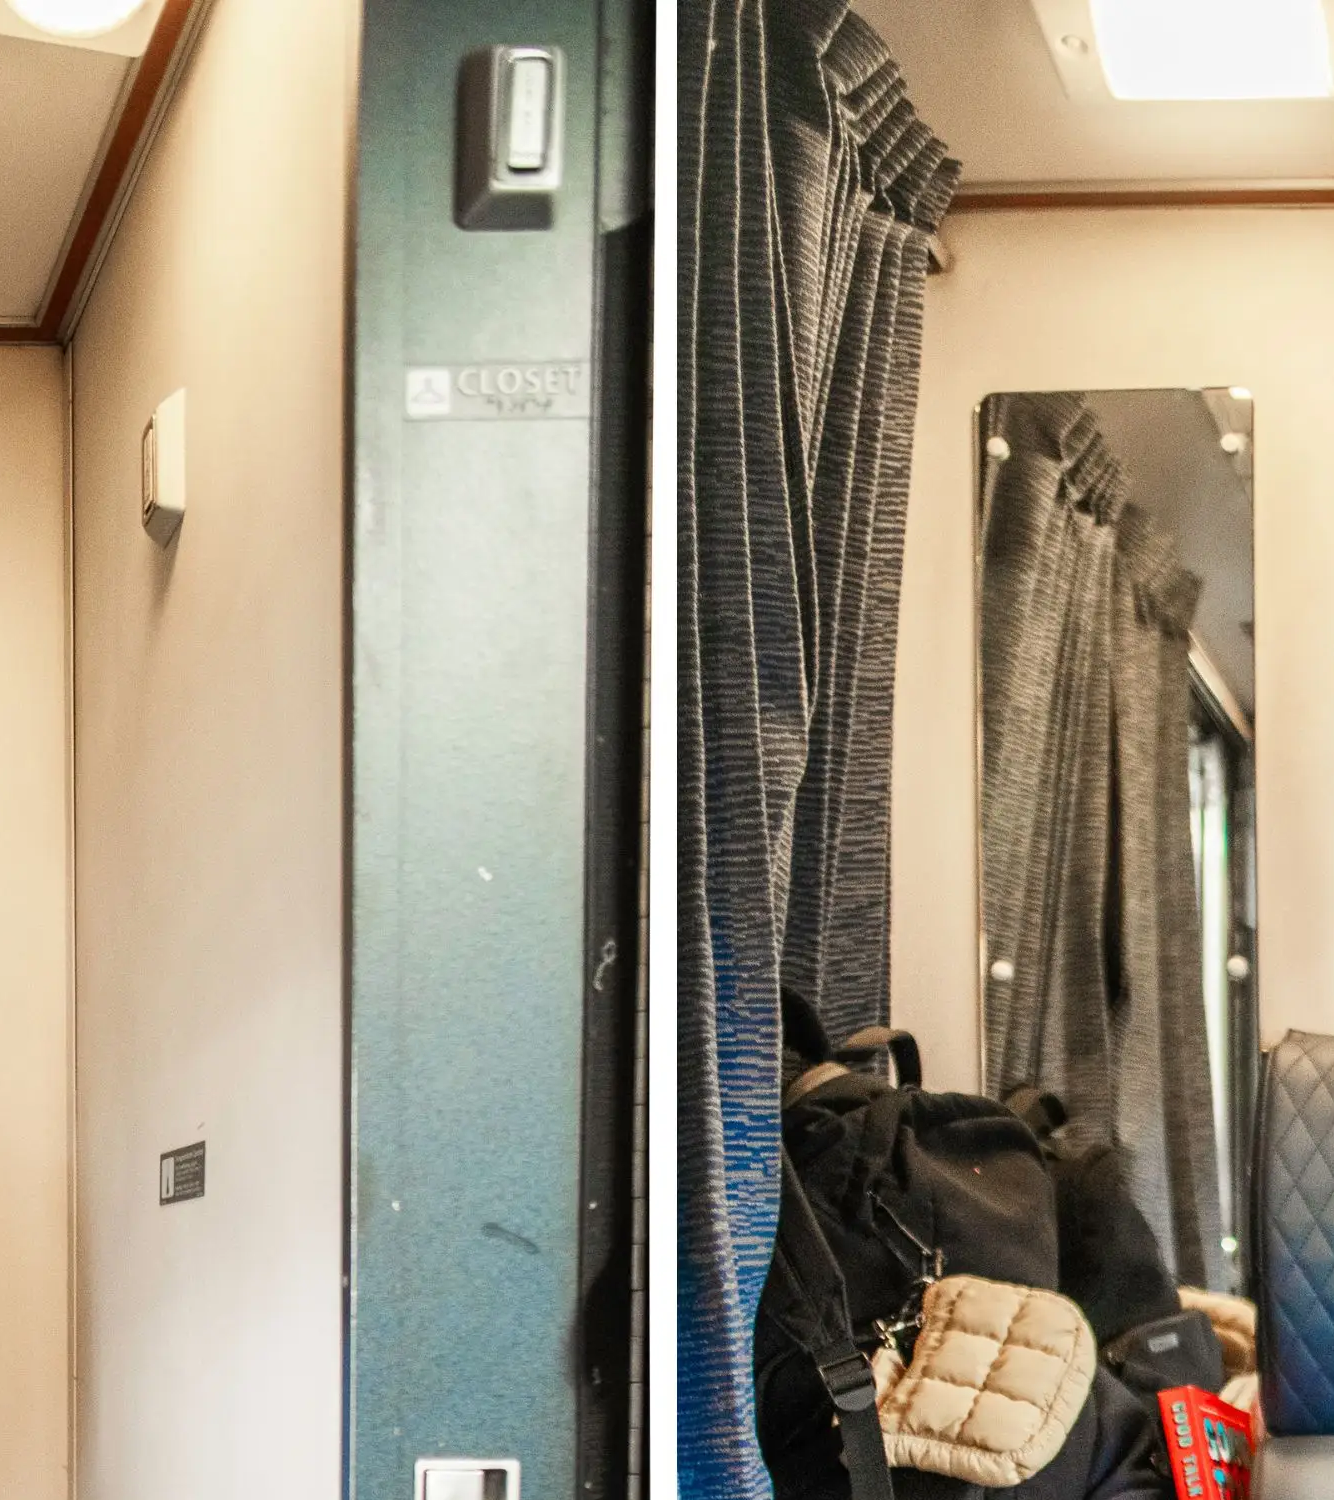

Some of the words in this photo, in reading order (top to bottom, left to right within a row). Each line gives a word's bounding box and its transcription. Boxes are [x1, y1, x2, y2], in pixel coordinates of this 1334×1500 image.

[455, 366, 582, 397] CLOSET
[1171, 1401, 1193, 1448] GOOD
[1182, 1454, 1203, 1497] TALK
